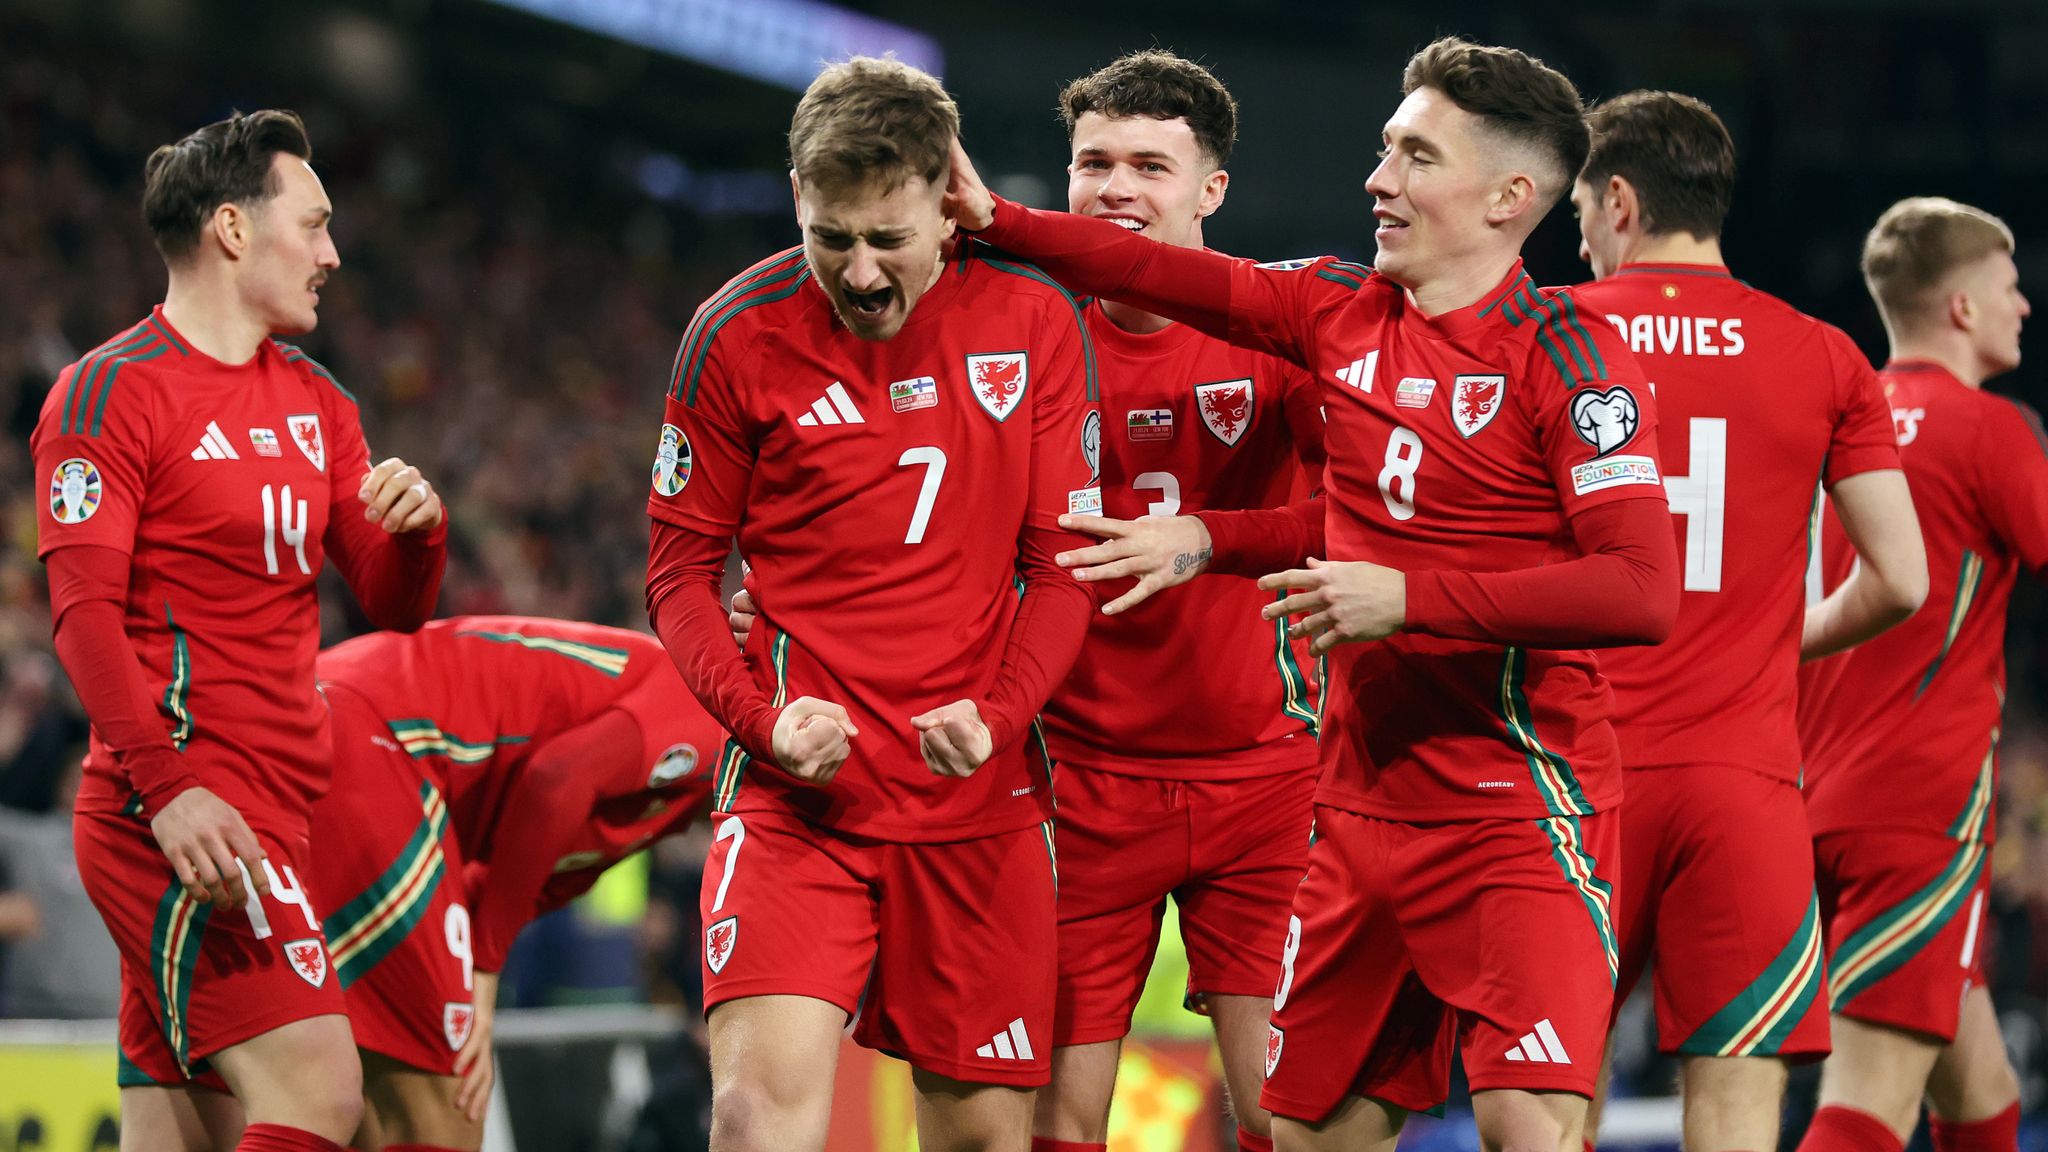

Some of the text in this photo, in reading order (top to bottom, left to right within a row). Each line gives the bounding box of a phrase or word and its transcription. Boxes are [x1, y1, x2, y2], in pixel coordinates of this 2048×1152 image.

[898, 446, 948, 544] 7
[1071, 497, 1102, 511] FOUN
[1377, 425, 1423, 521] 8
[1575, 464, 1657, 485] FOUNDATION
[261, 484, 312, 575] 14
[234, 856, 321, 940] 14
[711, 816, 746, 913] 7
[444, 902, 474, 992] 9
[1273, 914, 1303, 1012] 8
